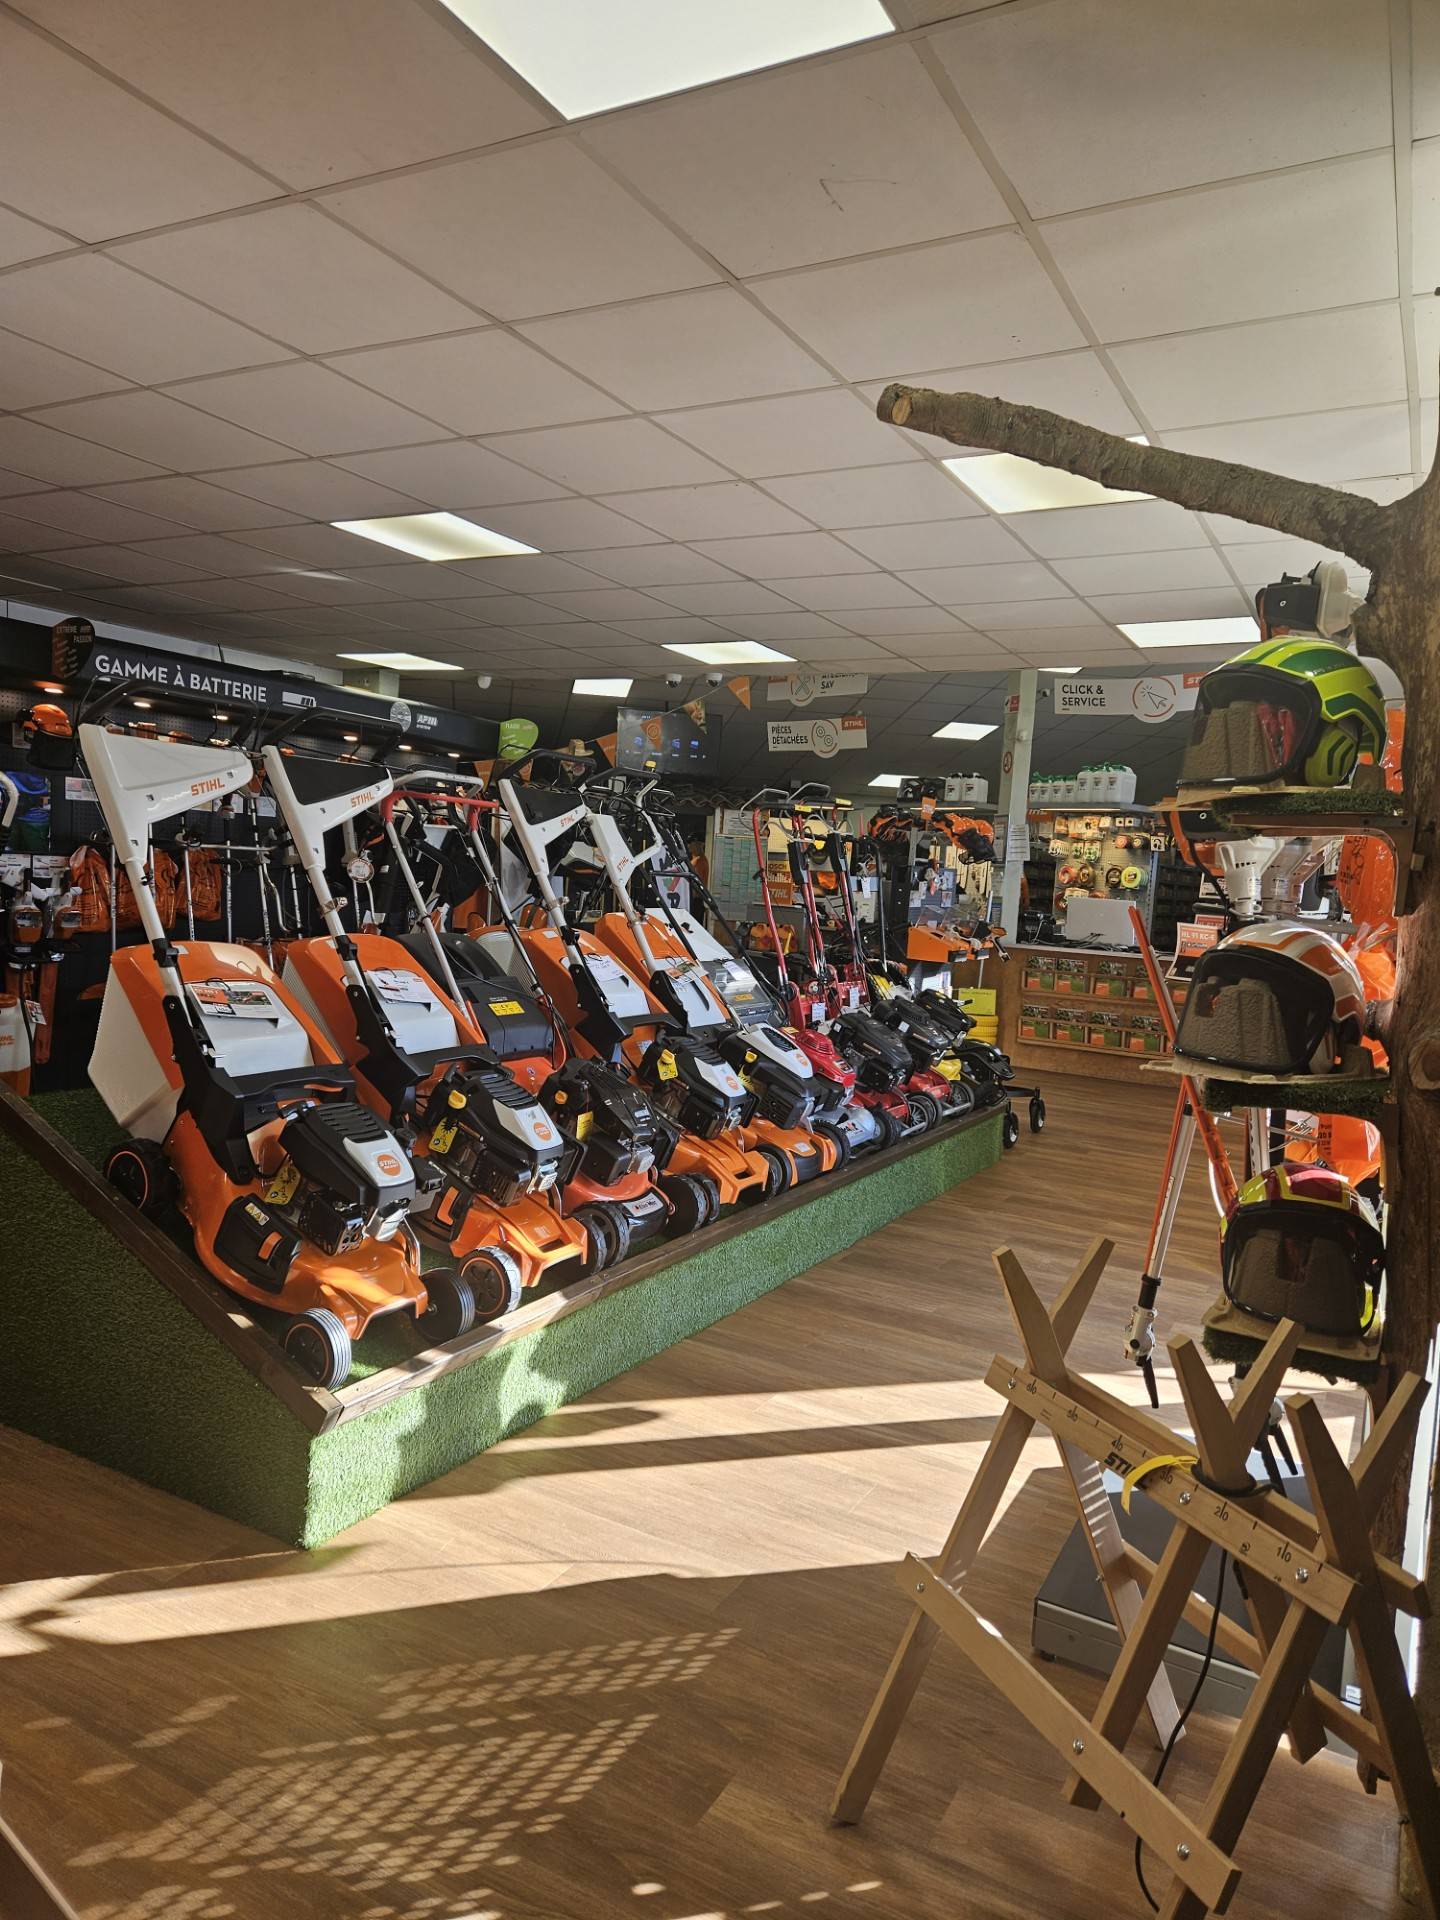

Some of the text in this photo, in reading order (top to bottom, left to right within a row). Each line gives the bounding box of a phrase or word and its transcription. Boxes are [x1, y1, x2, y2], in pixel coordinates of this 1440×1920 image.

[95, 654, 168, 684] GAMME
[173, 664, 185, 687] À
[190, 673, 267, 703] BATTERIE
[820, 681, 835, 690] SAV
[1061, 684, 1104, 695] CLICK &
[1061, 696, 1106, 707] SERVICE
[771, 723, 792, 735] PIÈCES
[843, 719, 864, 728] STIHL
[772, 732, 809, 745] DÉTACHÉES
[190, 778, 226, 797] STIHL
[351, 792, 375, 808] STIHL
[560, 813, 575, 828] STIHL
[616, 855, 629, 873] STIHL
[1213, 1505, 1229, 1521] 20
[1276, 1546, 1292, 1563] 10
